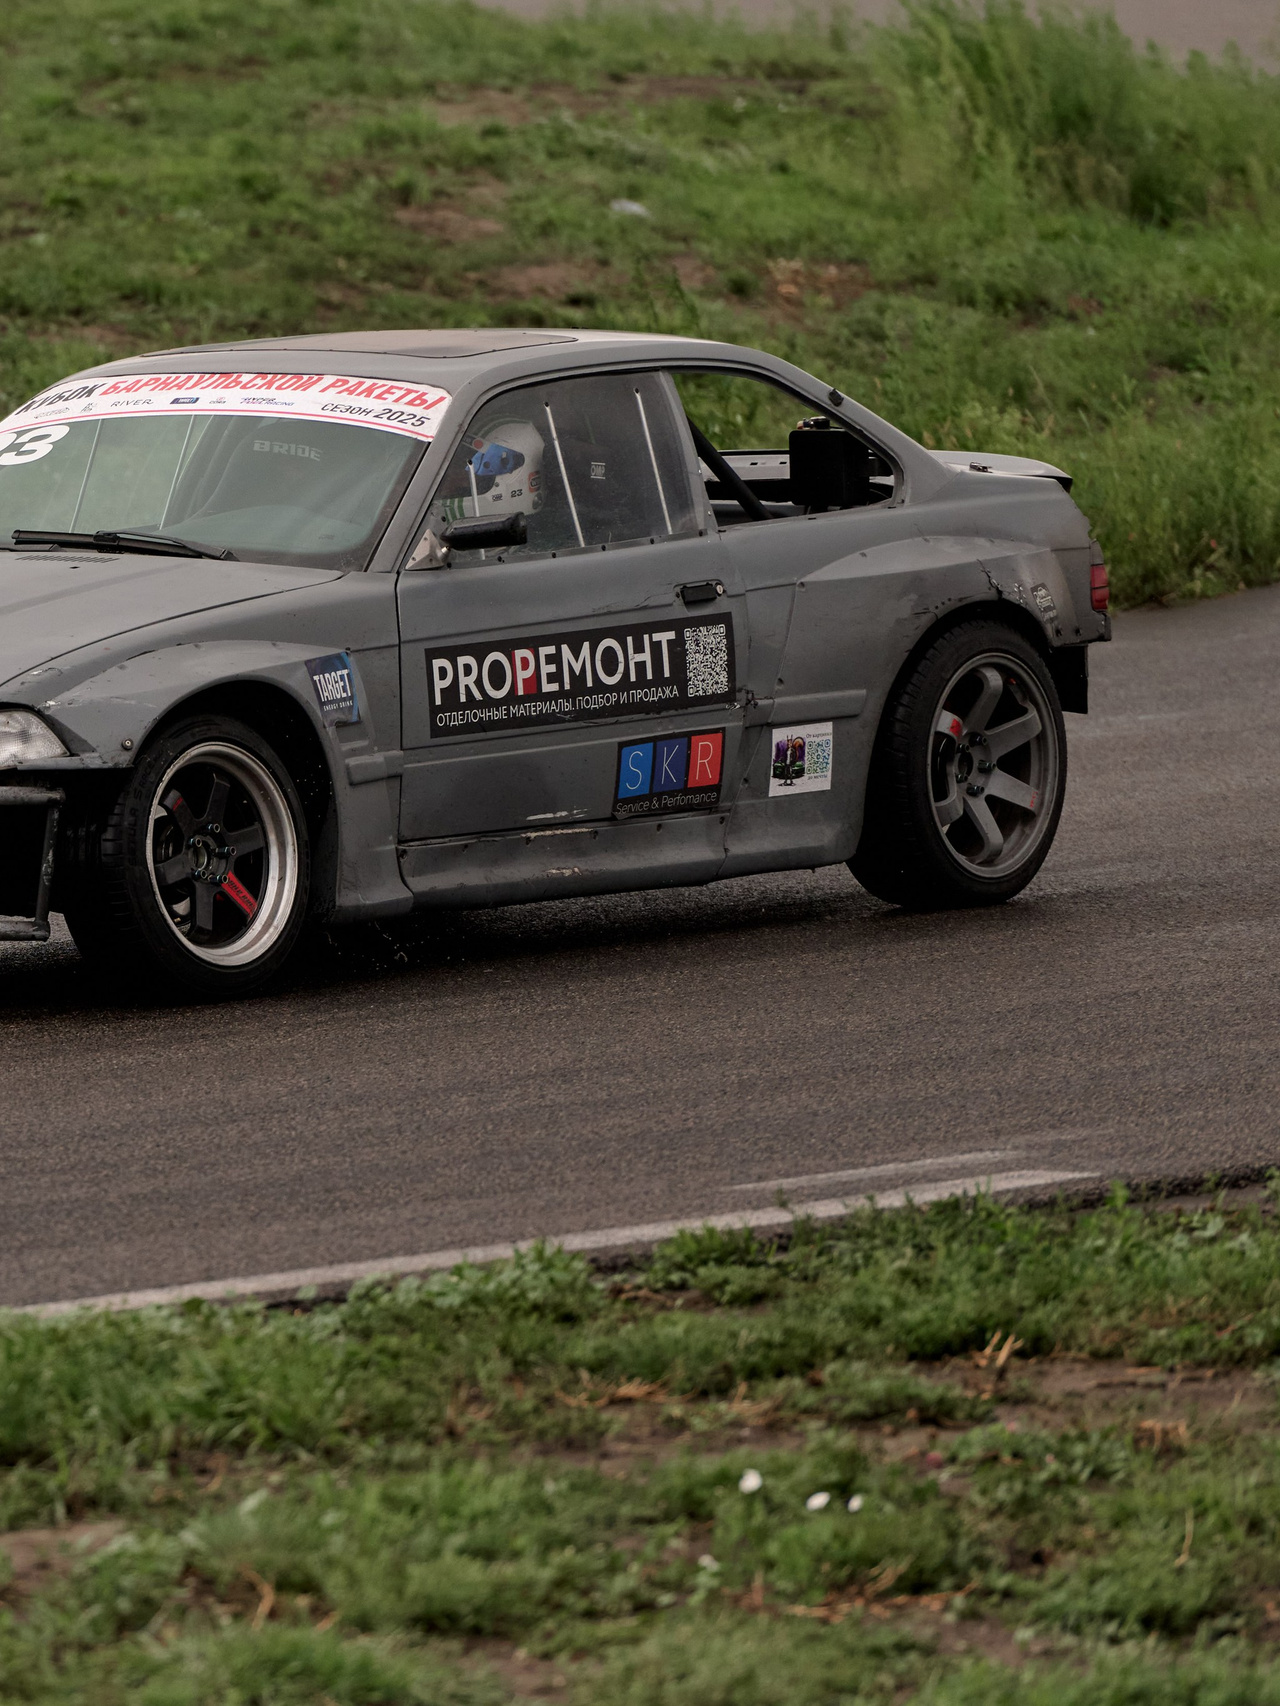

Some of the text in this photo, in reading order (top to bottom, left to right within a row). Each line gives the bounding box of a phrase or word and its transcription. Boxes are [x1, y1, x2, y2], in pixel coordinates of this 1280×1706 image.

[15, 383, 108, 415] КУБОК
[99, 373, 325, 396] БАРНАУЛЬСКОЙ
[319, 377, 447, 411] РАКЕТЫ
[110, 398, 154, 407] RIVER
[321, 402, 431, 429] СЕЗОН 2025
[253, 440, 323, 461] BRIDE
[511, 489, 523, 498] 23
[431, 630, 676, 706] PROРЕМОНТ
[313, 669, 351, 702] TARGET
[323, 700, 353, 711] ENERGY DRINK
[436, 685, 680, 727] ОТДЕЛОЧНЫЕ МАТЕРИАЛЫ. ПОДБОР И ПРОДАЖА
[626, 741, 713, 790] SKR
[616, 791, 718, 815] Service & Perfomance
